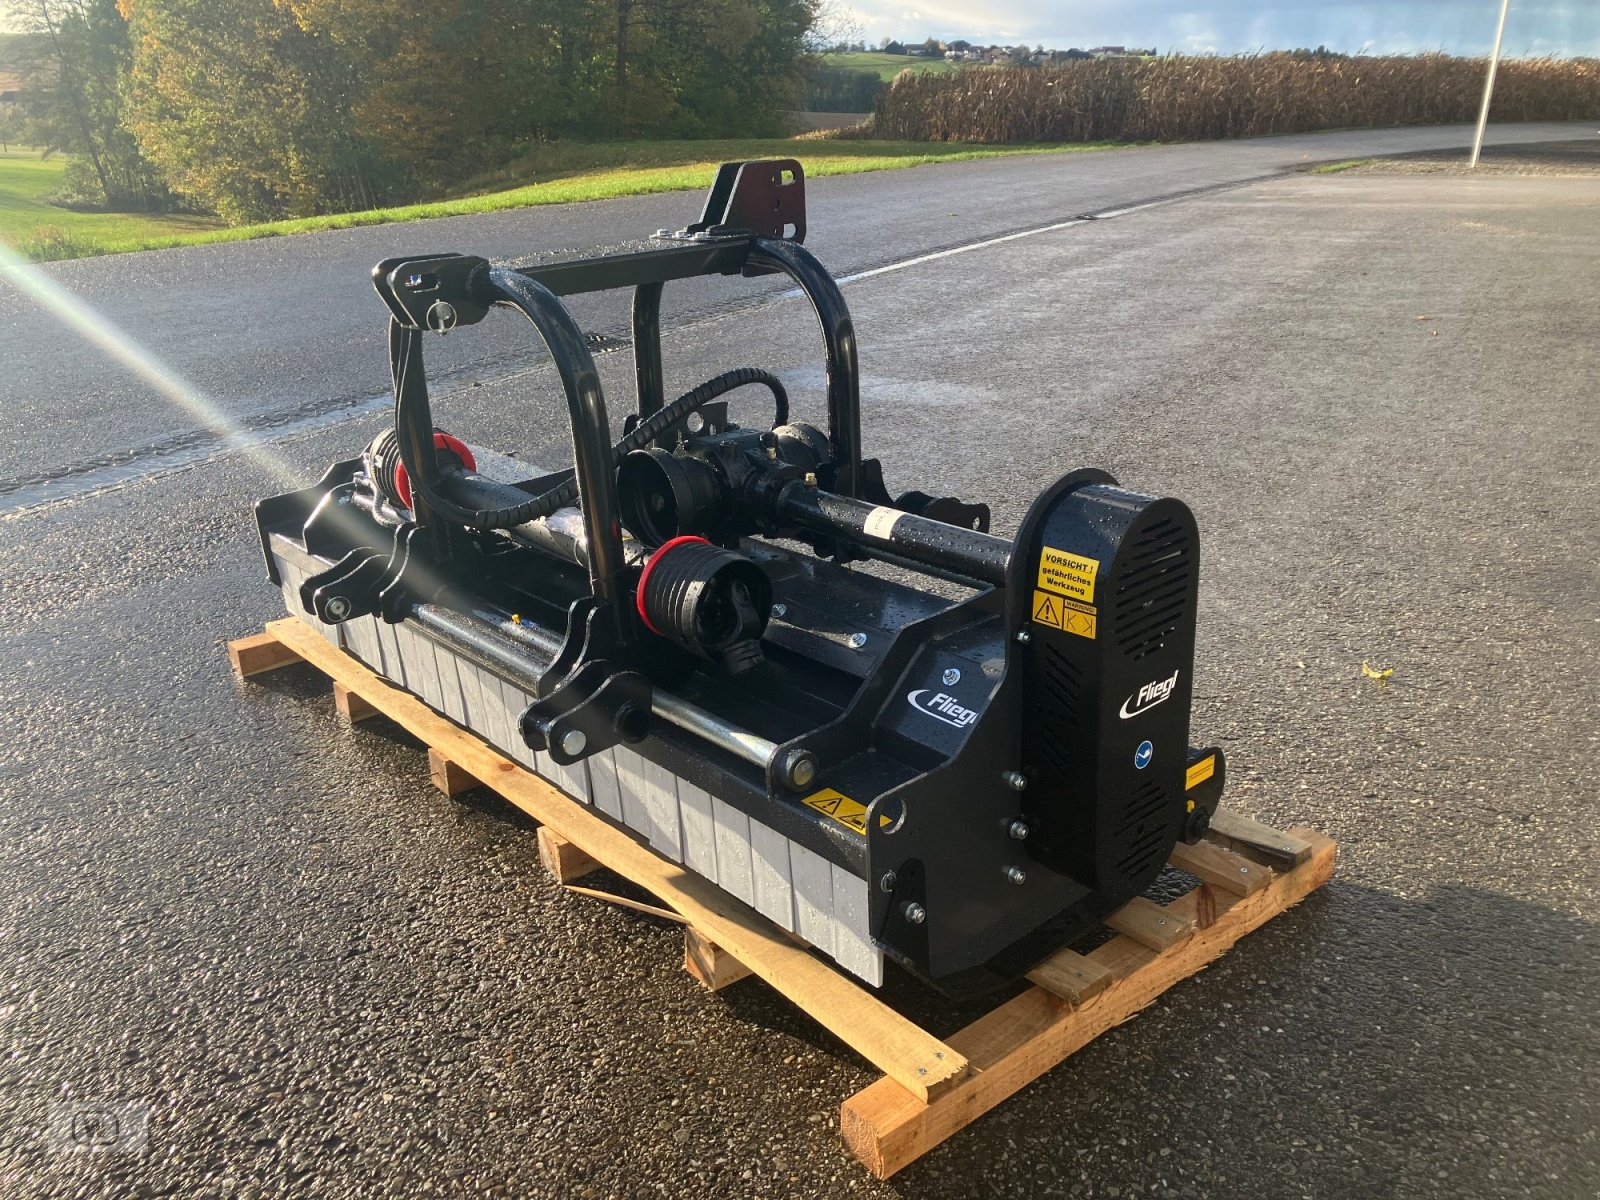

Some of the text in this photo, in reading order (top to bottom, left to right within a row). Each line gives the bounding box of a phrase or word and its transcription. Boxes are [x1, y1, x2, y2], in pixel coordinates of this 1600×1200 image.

[1042, 567, 1091, 586] gefährliches
[1046, 577, 1085, 595] Werkzeug
[1136, 669, 1179, 707] Fliegl
